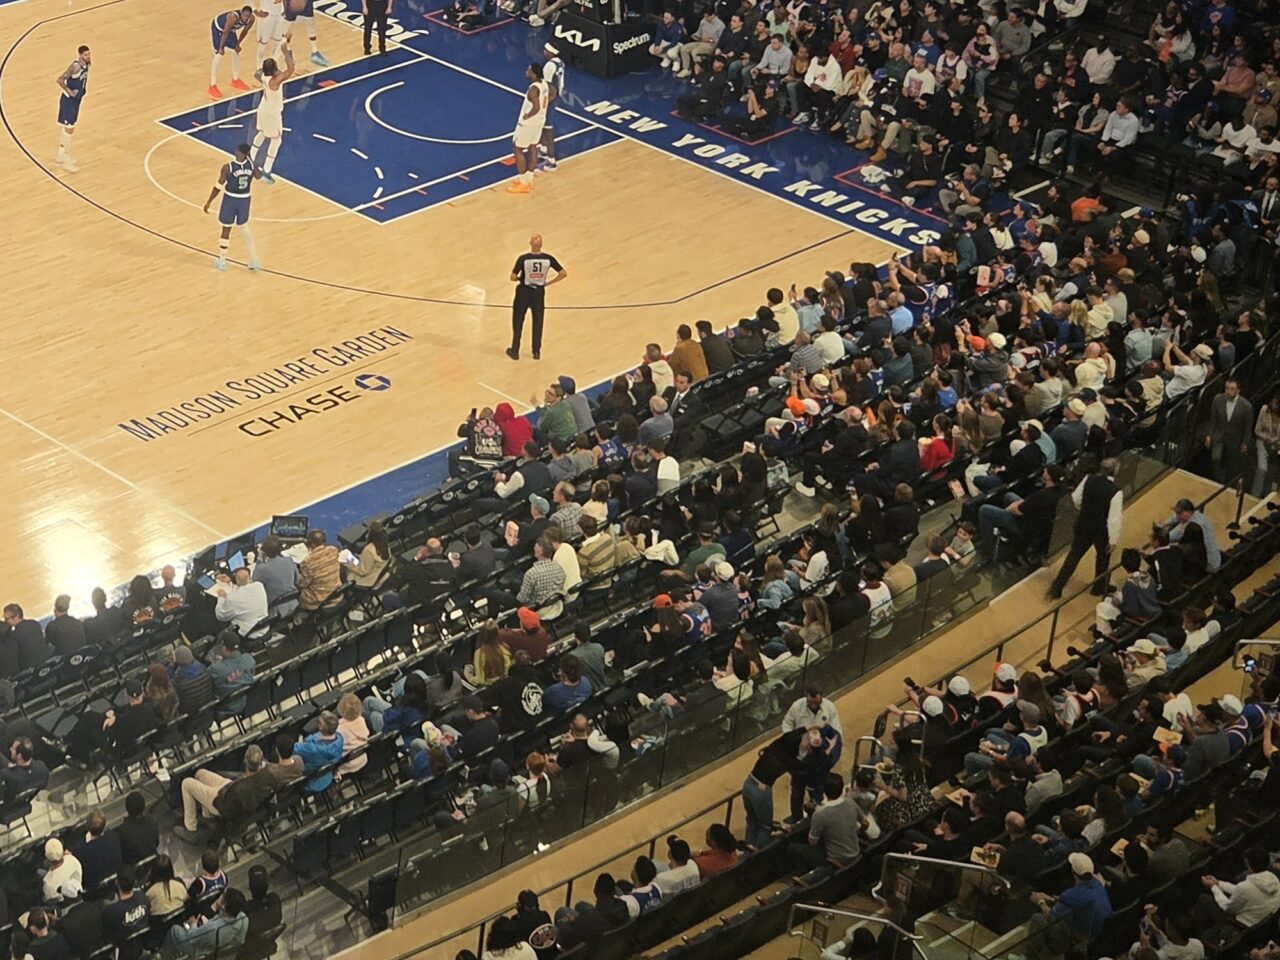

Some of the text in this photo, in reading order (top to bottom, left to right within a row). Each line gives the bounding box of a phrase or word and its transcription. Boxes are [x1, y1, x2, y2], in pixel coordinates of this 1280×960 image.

[612, 32, 650, 54] Spectrum
[238, 176, 248, 189] 5
[583, 99, 943, 246] NEW YORK KNICKS
[532, 262, 542, 273] 51
[119, 325, 414, 441] MADISON SQUARE GARDEN
[238, 385, 361, 437] CHASE
